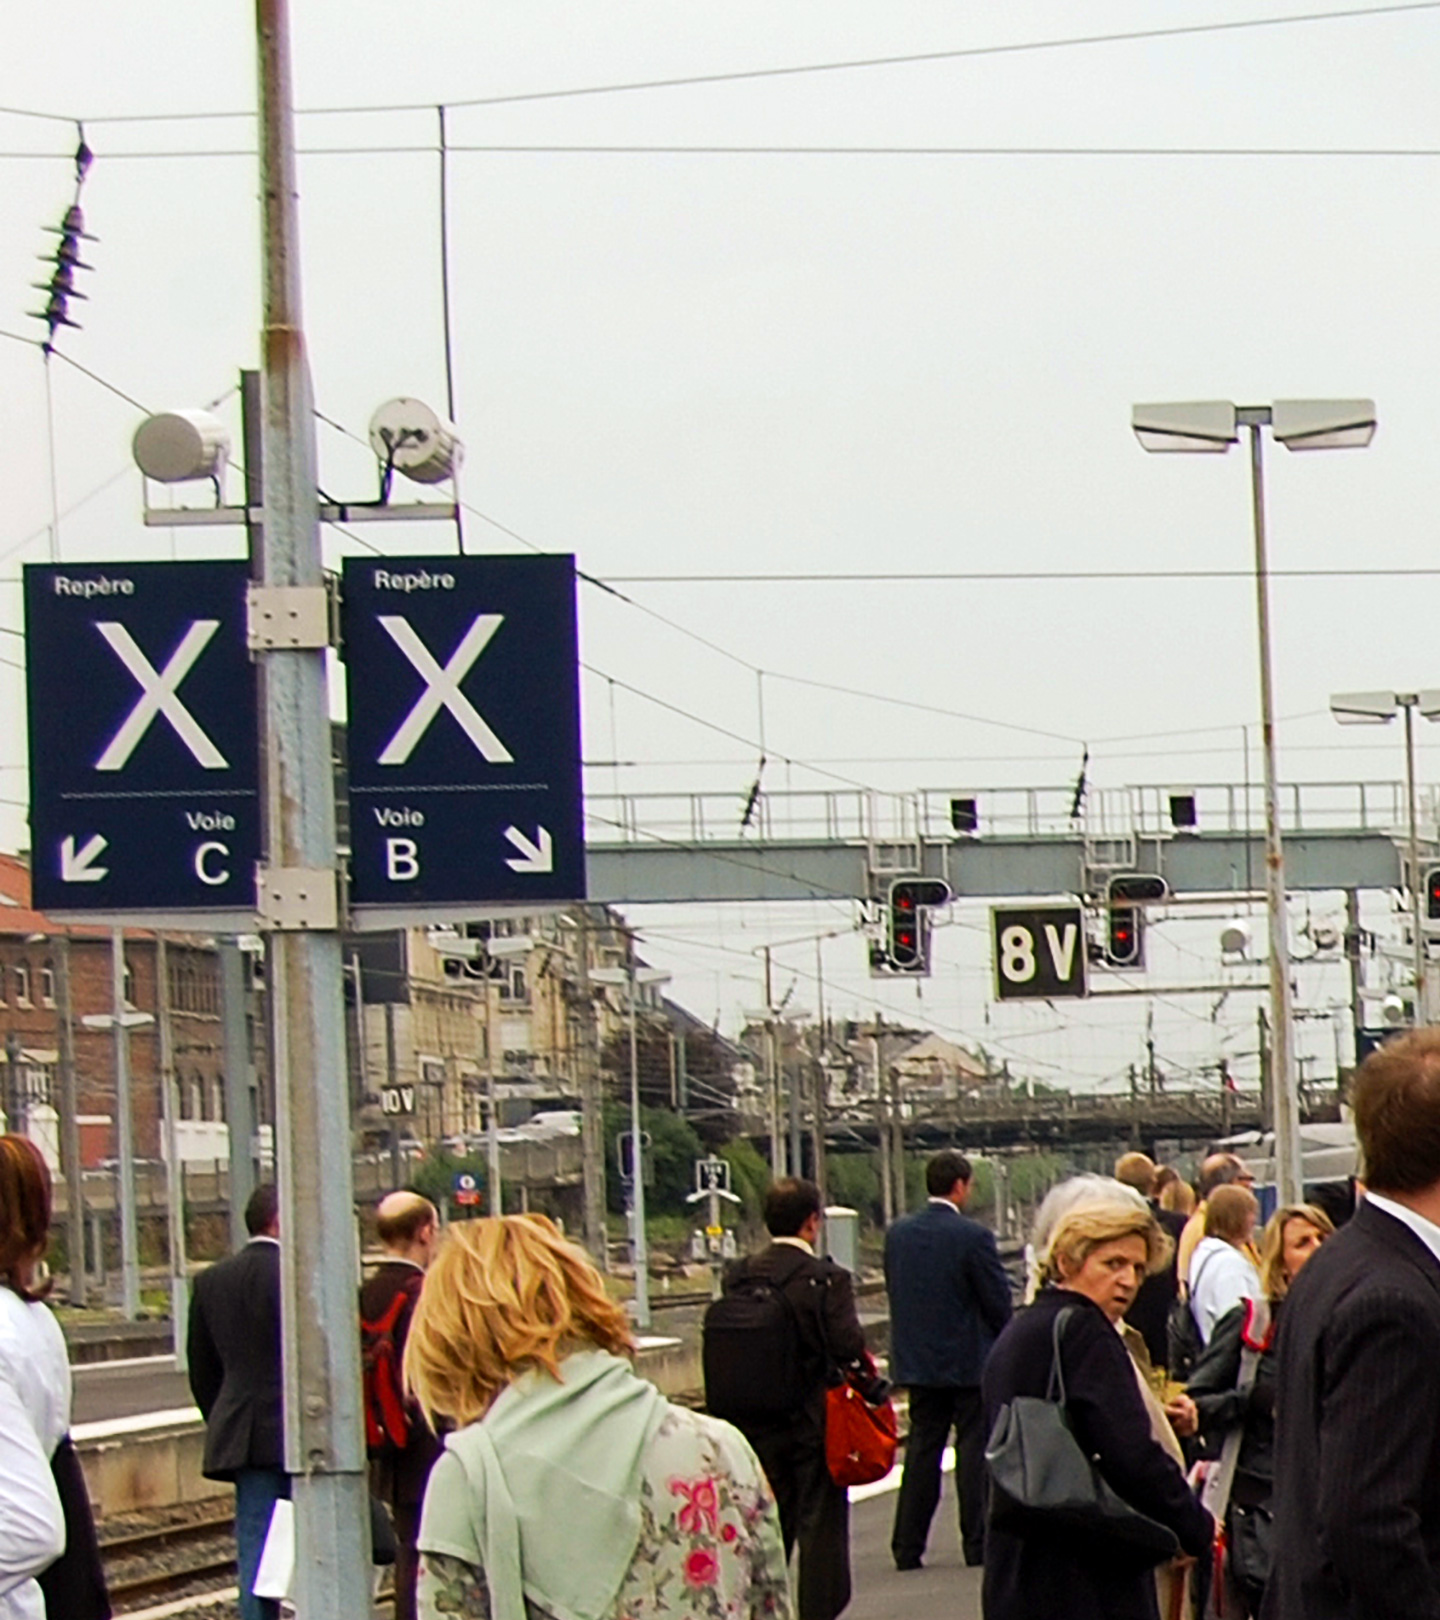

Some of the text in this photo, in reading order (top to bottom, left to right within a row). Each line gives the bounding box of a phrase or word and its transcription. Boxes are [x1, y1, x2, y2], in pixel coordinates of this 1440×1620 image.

[53, 574, 136, 598] Repère
[374, 568, 456, 592] Repère
[94, 618, 231, 772] X
[375, 613, 516, 765] X
[185, 810, 236, 832] Voie
[374, 806, 425, 828] Voie
[193, 841, 231, 886] C
[386, 838, 420, 881] B
